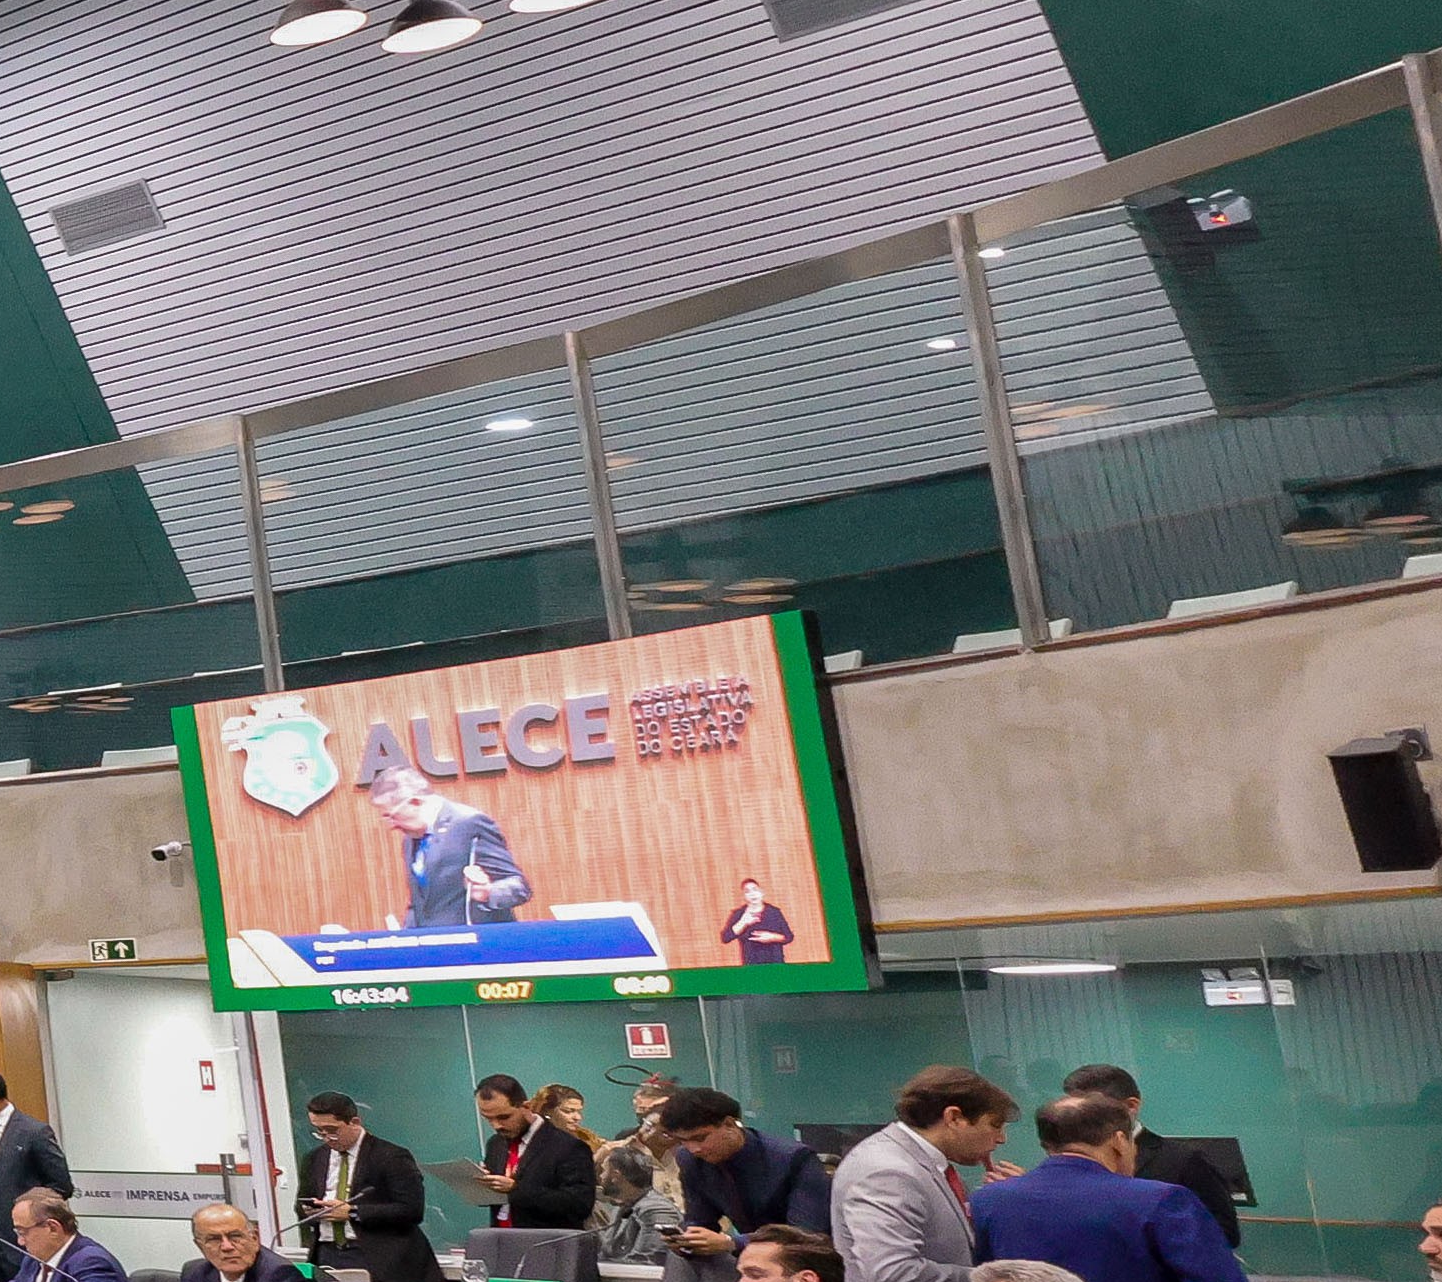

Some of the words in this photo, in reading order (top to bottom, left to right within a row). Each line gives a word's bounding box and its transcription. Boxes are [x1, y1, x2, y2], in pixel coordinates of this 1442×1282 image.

[635, 721, 660, 737] DO
[670, 709, 745, 732] ESTADO
[355, 693, 616, 788] ALECE
[637, 739, 661, 754] DO
[331, 986, 410, 1005] 16:43:04
[477, 981, 534, 1000] 00:07
[84, 1190, 112, 1199] ALECE
[126, 1190, 191, 1202] IMPRENSA
